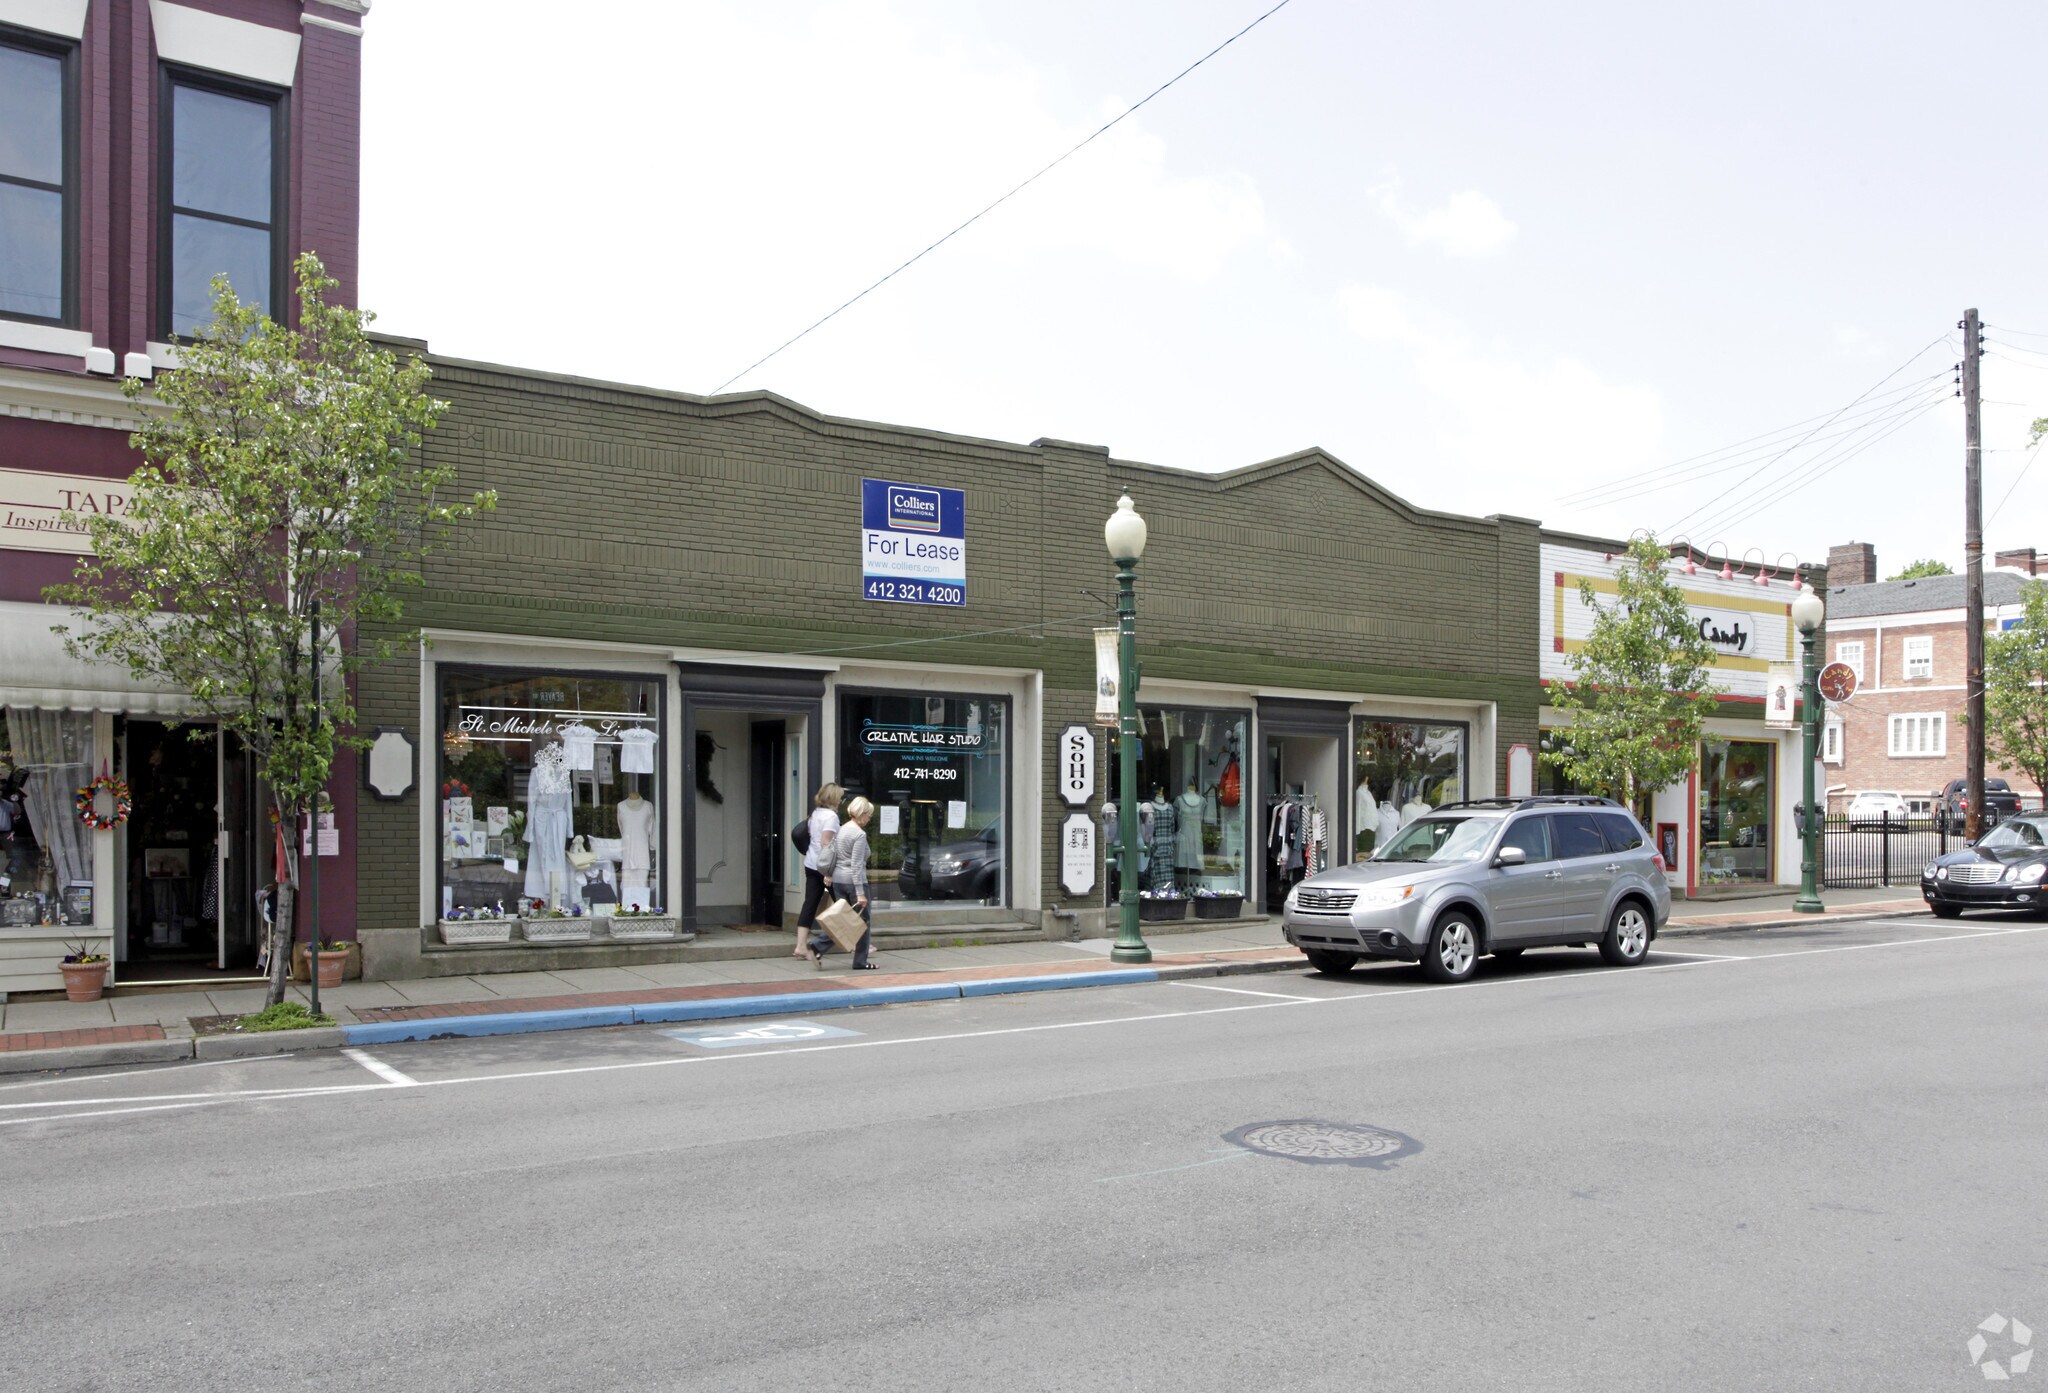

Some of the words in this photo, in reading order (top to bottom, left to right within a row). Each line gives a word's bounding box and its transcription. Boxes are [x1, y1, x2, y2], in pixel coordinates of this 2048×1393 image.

[894, 495, 934, 511] Colliers
[894, 508, 934, 516] INTERNATIONAL
[6, 511, 89, 532] Inspired
[868, 533, 899, 555] For
[905, 537, 959, 561] Lease
[867, 560, 940, 574] www.colliers.com
[869, 581, 895, 598] 412
[899, 583, 923, 600] 321
[927, 586, 960, 603] 4200
[1700, 617, 1747, 650] Candy
[1823, 668, 1854, 680] Candy
[459, 714, 486, 733] St.
[489, 716, 552, 735] Michele
[867, 731, 919, 744] CREATIVE
[922, 731, 945, 744] HAIR
[948, 734, 981, 746] STUDIO
[894, 767, 957, 780] 412-741-8290
